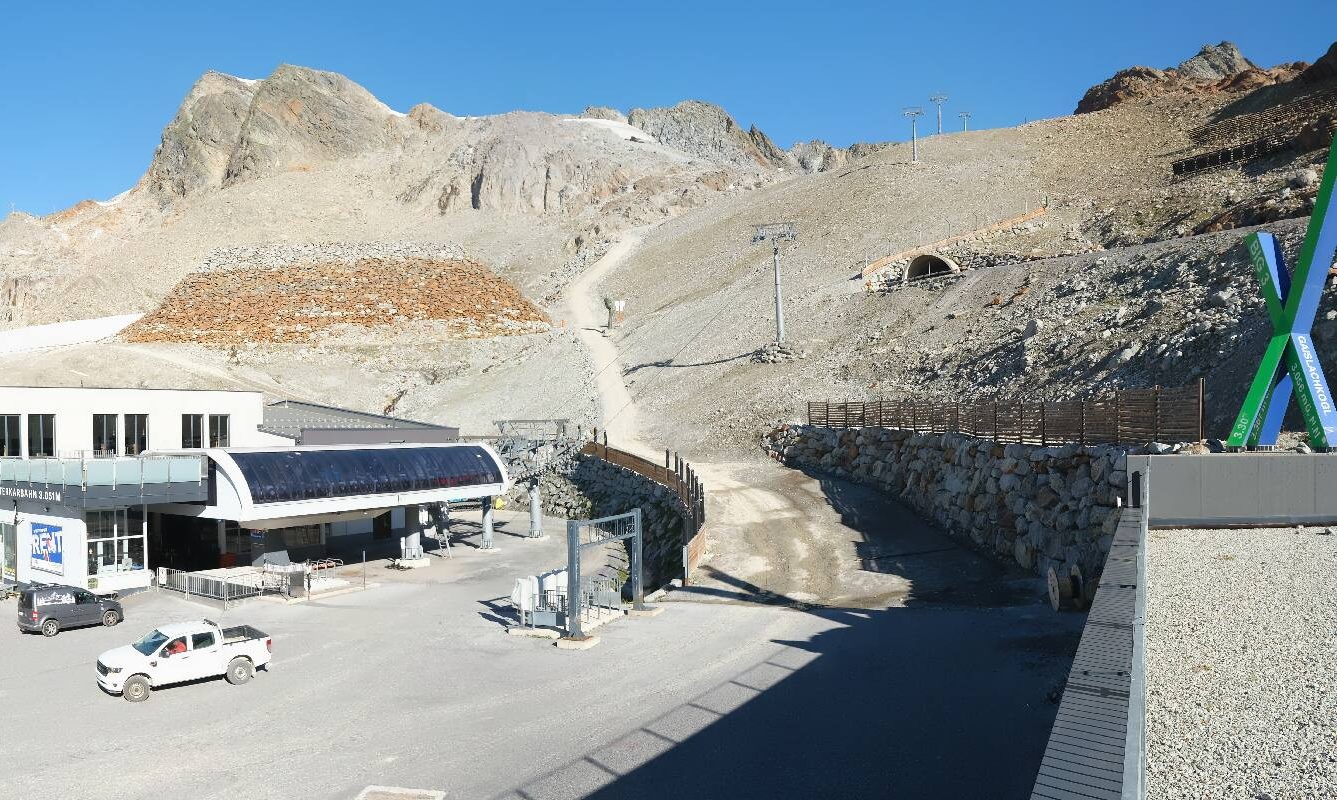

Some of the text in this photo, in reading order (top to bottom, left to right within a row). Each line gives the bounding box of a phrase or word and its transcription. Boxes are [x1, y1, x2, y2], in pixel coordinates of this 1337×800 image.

[1250, 240, 1270, 286] BIG 3
[1297, 335, 1332, 416] GAISLACHKOGL
